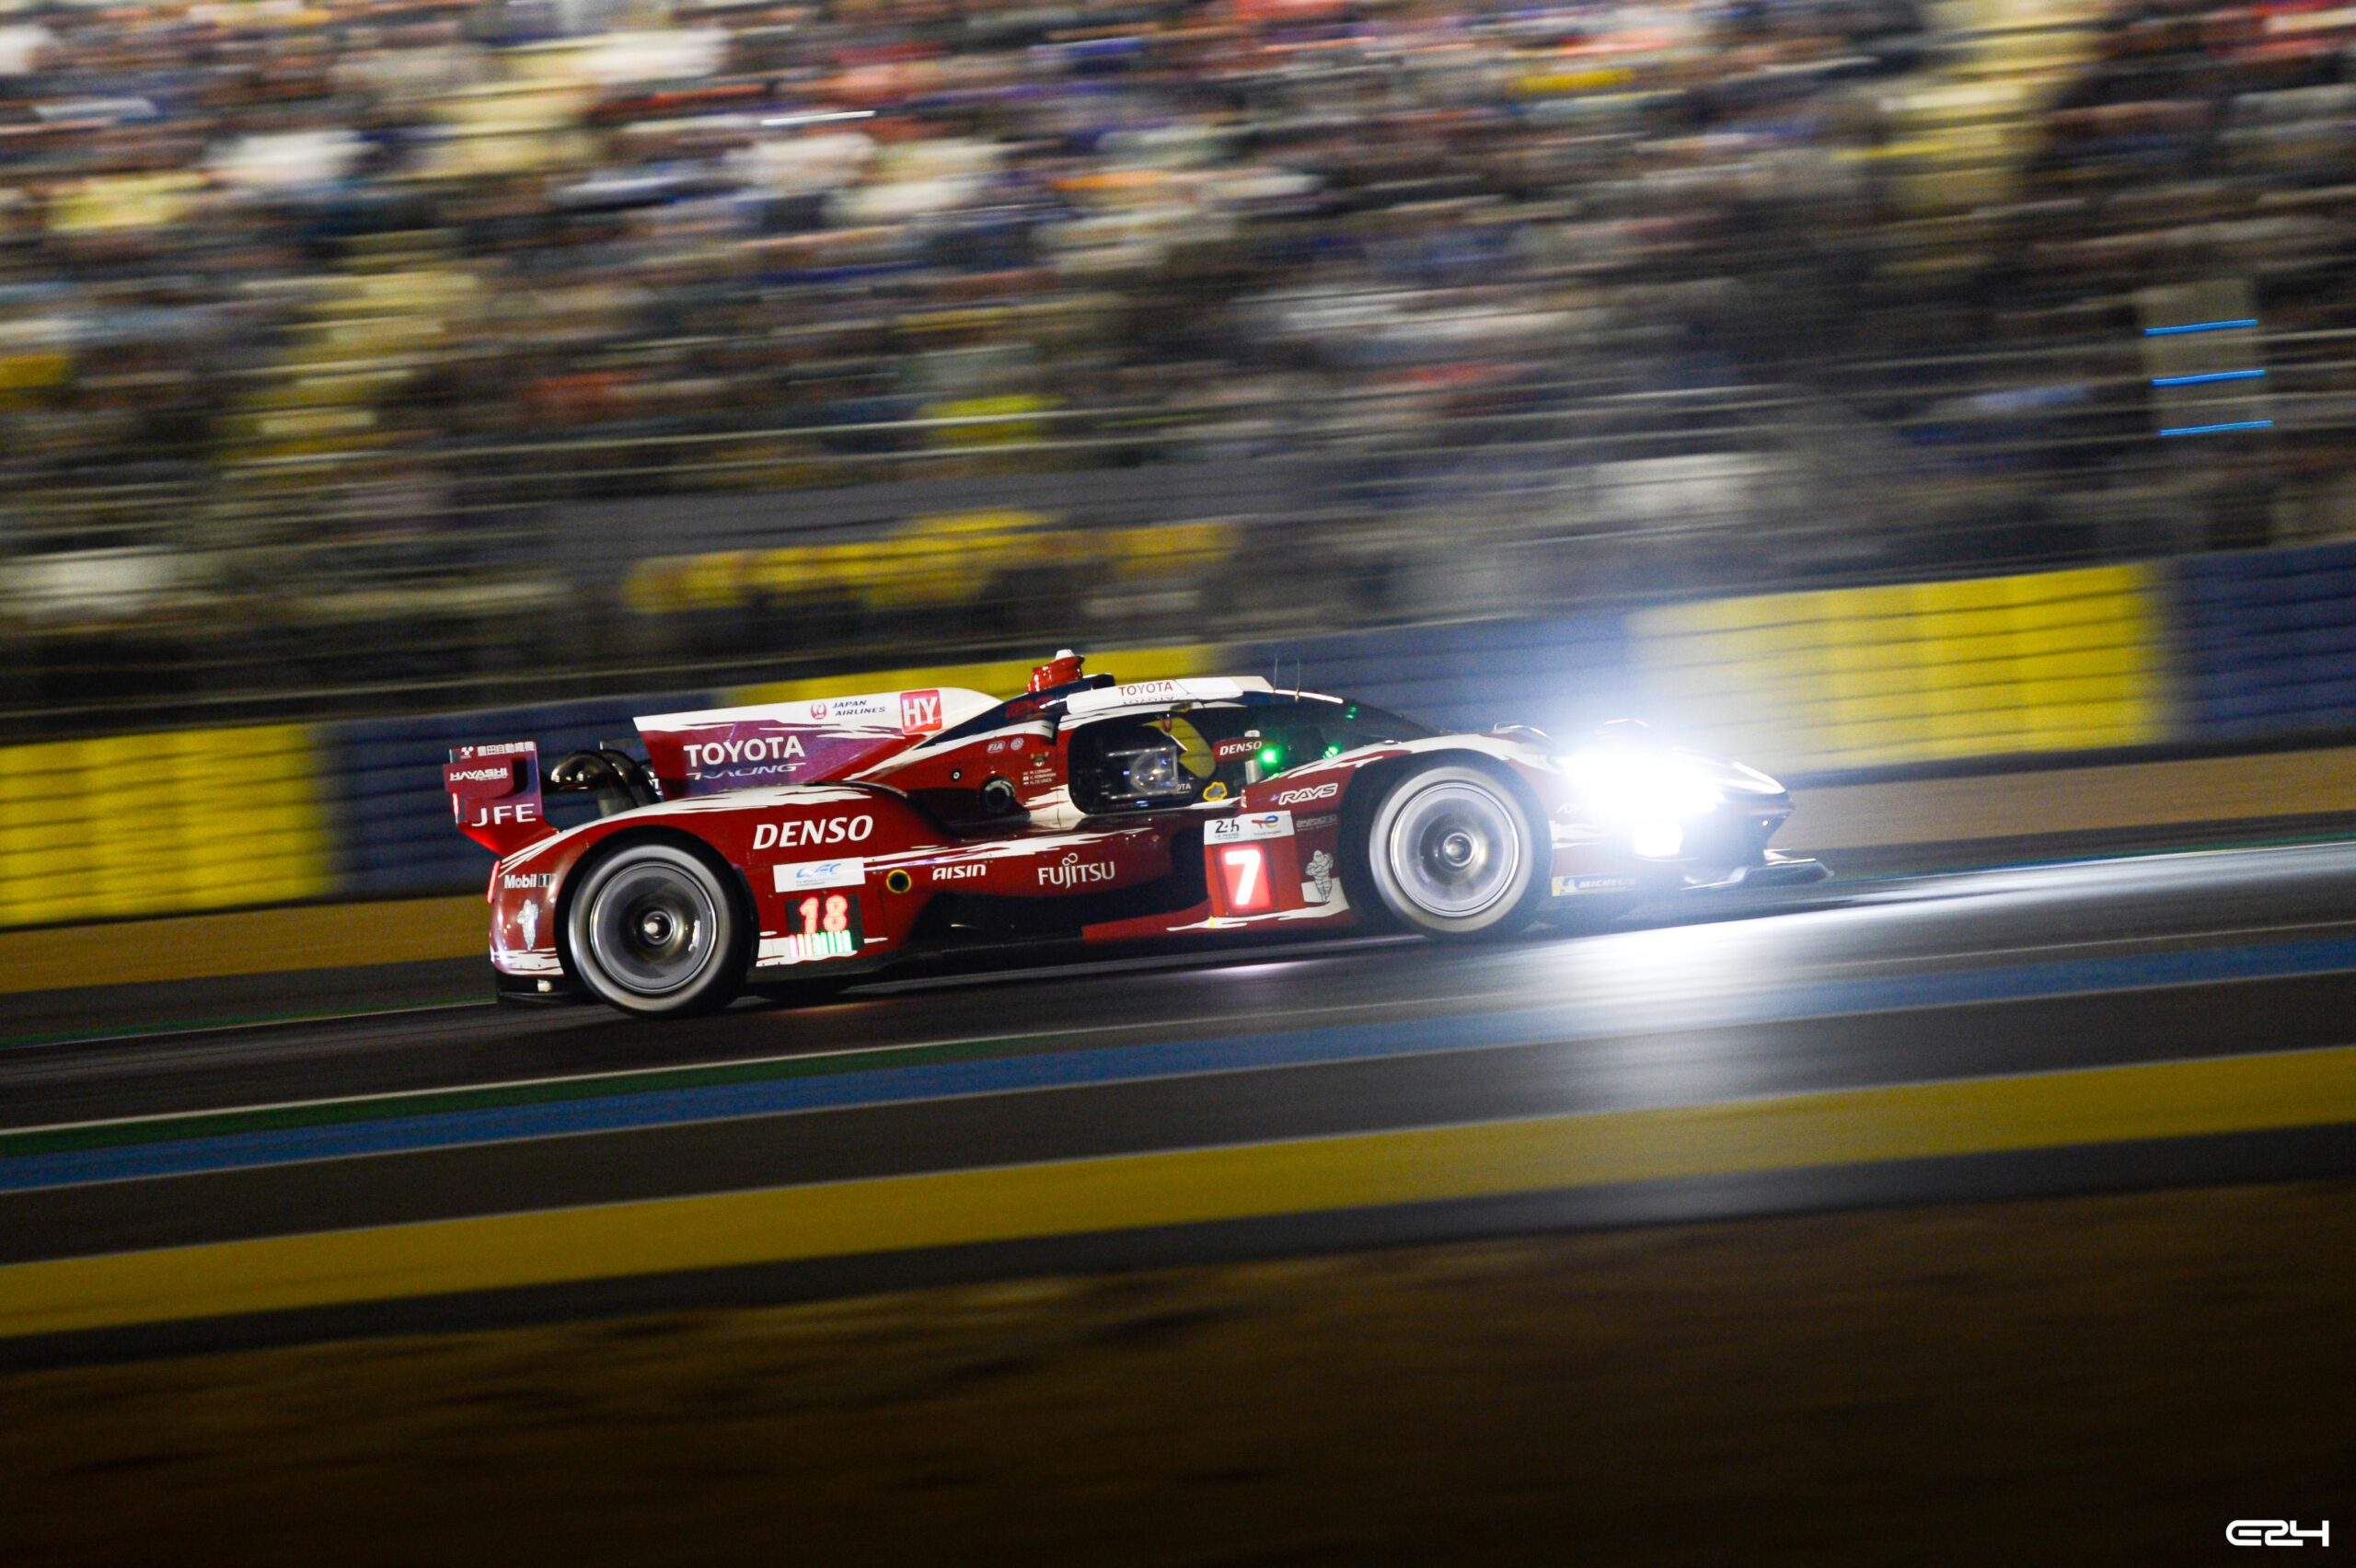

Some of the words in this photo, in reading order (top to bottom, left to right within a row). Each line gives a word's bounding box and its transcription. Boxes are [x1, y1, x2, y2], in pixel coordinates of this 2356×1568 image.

[1118, 681, 1173, 698] TOYOTA
[832, 699, 866, 709] JAPAN
[835, 707, 886, 717] AIRLINES
[903, 696, 937, 727] HY
[683, 735, 805, 767] TOYOTA
[987, 743, 1003, 751] FIA
[1218, 740, 1263, 756] DENSO
[448, 767, 508, 781] HAYASHI
[1278, 782, 1339, 806] RAYS
[471, 803, 537, 827] JFE
[752, 815, 874, 850] DENSO
[503, 873, 537, 890] Mobil
[932, 863, 987, 881] AISIN
[1037, 860, 1115, 890] FUJITSU
[1224, 849, 1262, 906] 7
[798, 894, 849, 935] 18
